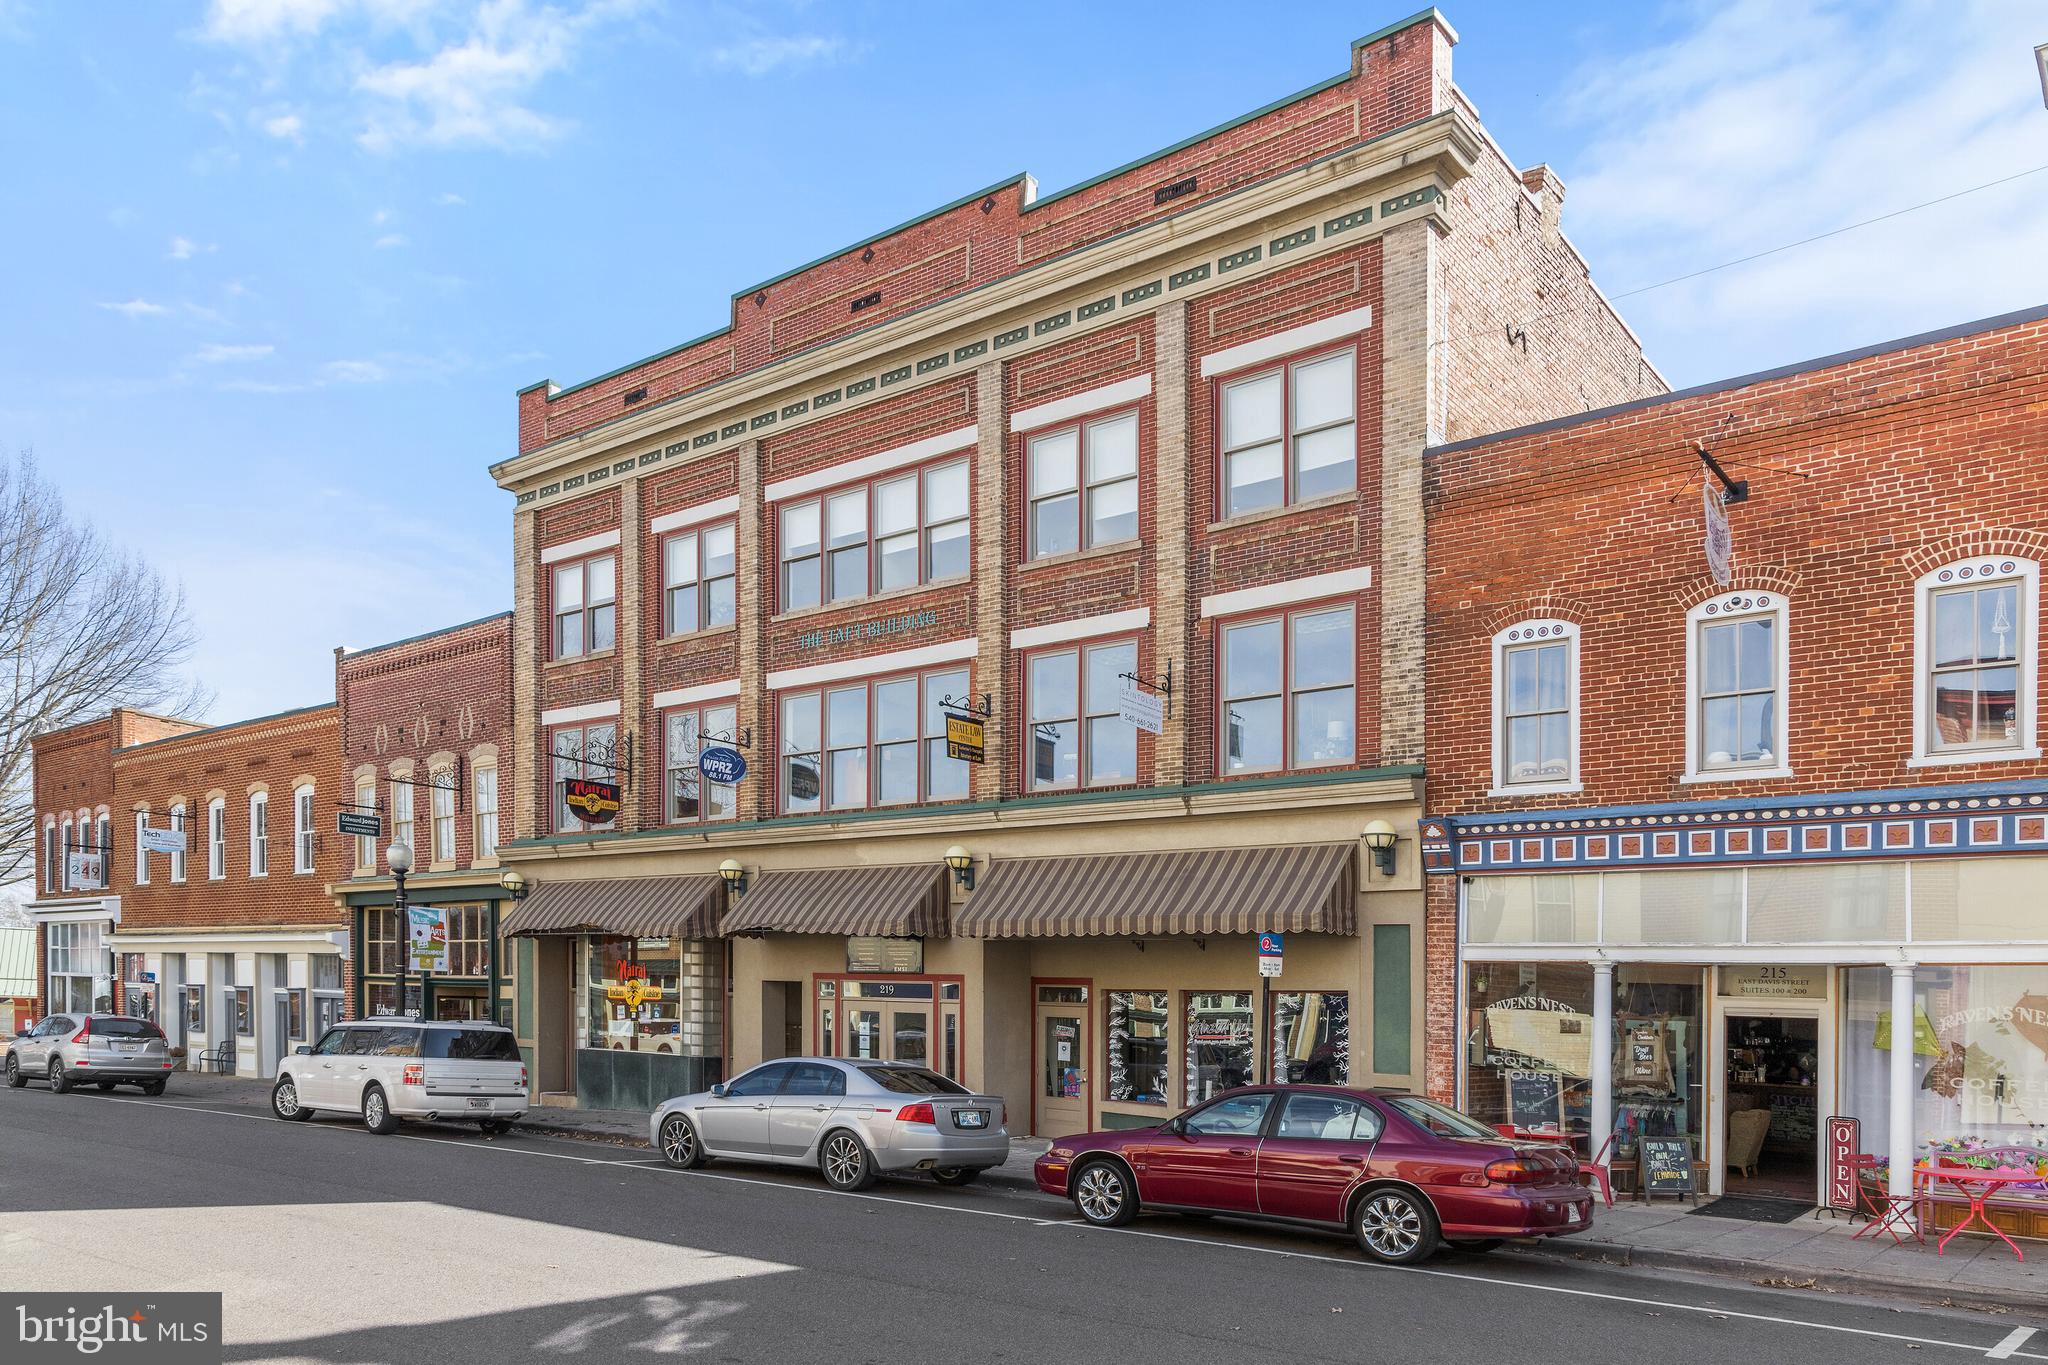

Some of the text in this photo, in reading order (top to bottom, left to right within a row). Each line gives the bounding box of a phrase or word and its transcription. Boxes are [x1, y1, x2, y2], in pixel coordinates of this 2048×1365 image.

[800, 610, 938, 649] THE TAFT BUILDING
[949, 720, 982, 737] ESTATE LAW
[703, 758, 733, 774] WPRZ
[708, 771, 722, 779] 88.1
[341, 815, 379, 826] Edward Jones
[1760, 967, 1787, 979] 215
[609, 989, 660, 998] Indian Cuisine
[880, 985, 894, 995] 219
[376, 1003, 397, 1016] Edwar
[2015, 1007, 2048, 1026] NE
[1633, 1045, 1649, 1054] Draft
[1492, 1056, 1562, 1068] COFFE
[1638, 1052, 1653, 1061] Beer
[1496, 1069, 1562, 1082] HOUSE
[1634, 1066, 1651, 1075] Wine
[1950, 1077, 2048, 1090] COFFE
[1835, 1127, 1850, 1200] OPEN
